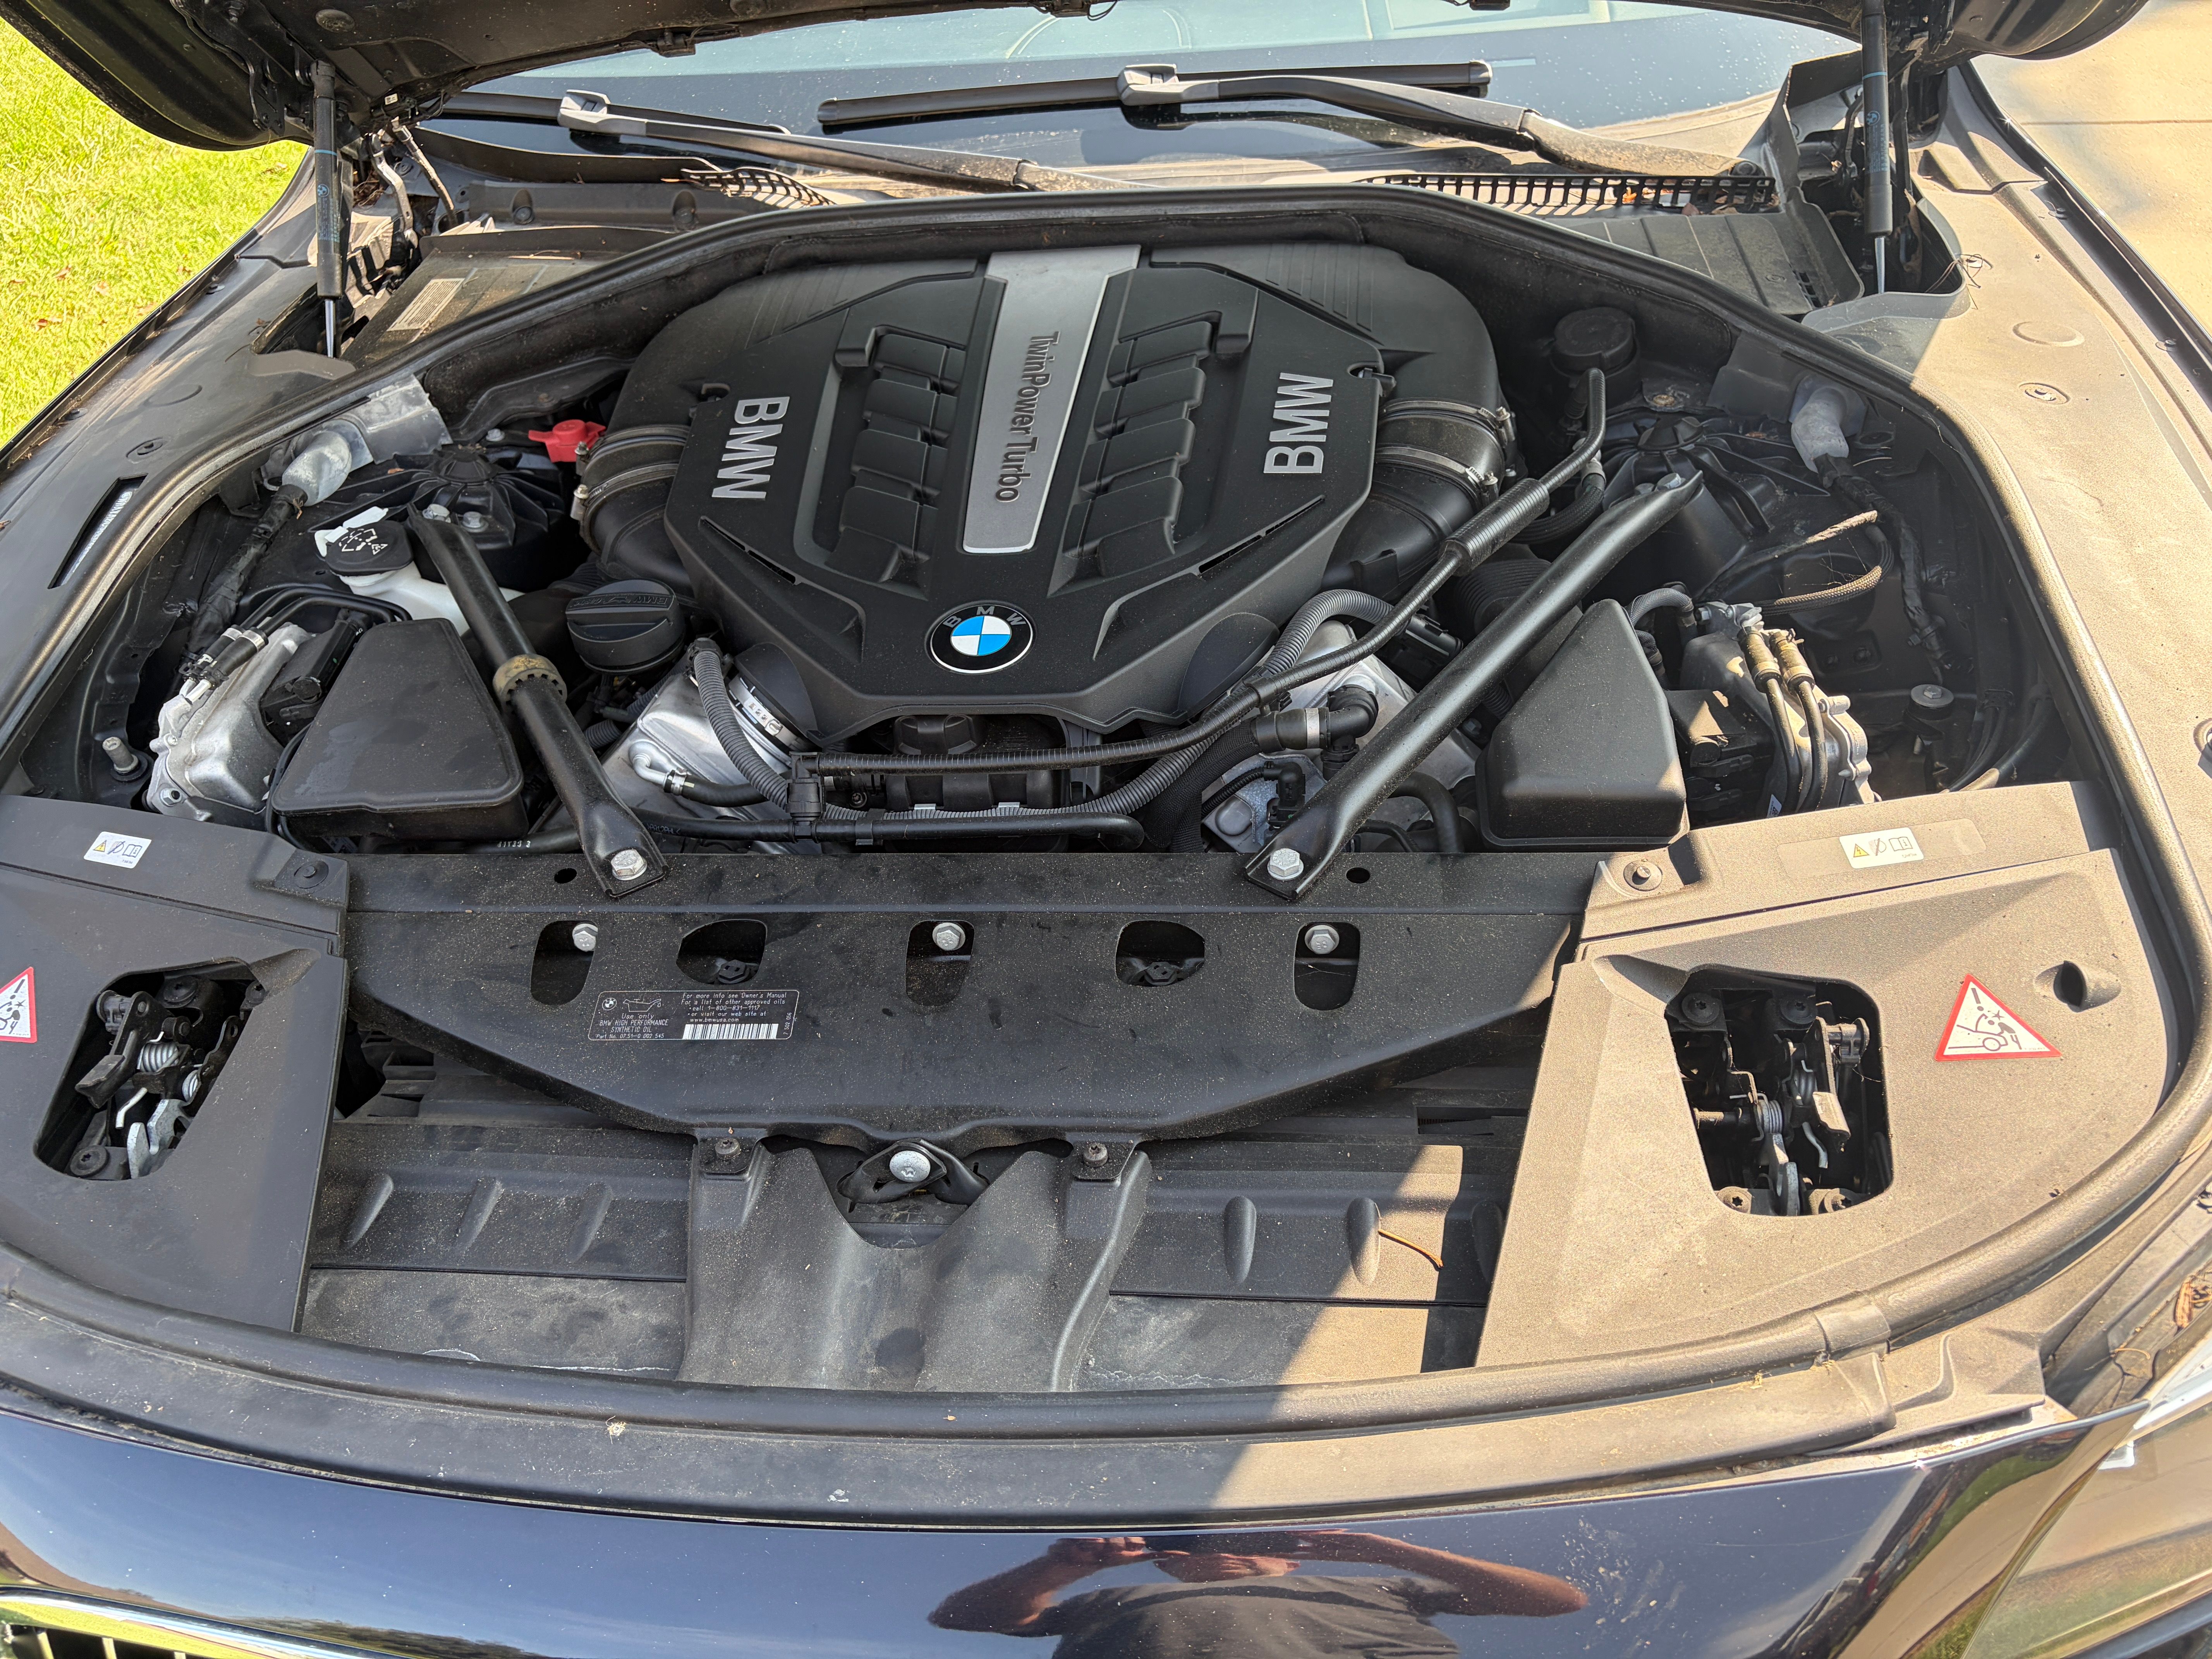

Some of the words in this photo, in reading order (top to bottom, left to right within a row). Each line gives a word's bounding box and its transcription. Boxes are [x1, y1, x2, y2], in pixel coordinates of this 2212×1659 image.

[1009, 331, 1061, 436] TwinPower
[1263, 372, 1333, 474] BMW
[711, 396, 790, 499] BMW
[995, 436, 1039, 502] Turbo
[633, 596, 668, 605] BMW
[943, 606, 1026, 628] BMW
